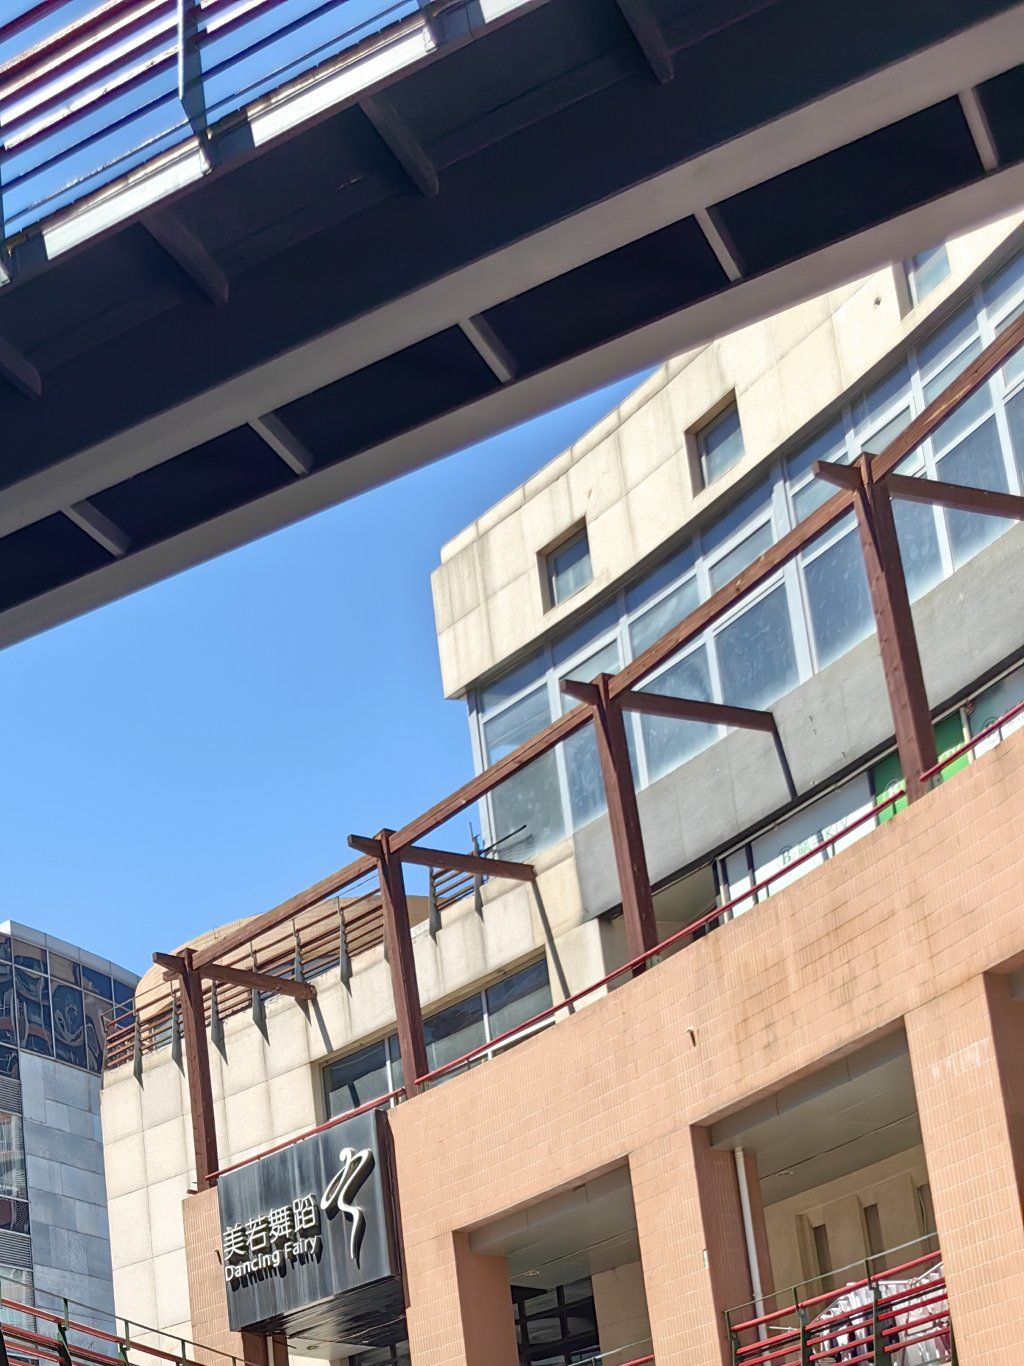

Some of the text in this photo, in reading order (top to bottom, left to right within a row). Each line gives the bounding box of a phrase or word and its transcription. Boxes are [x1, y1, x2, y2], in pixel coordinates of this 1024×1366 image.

[223, 1193, 317, 1260] 美若舞蹈
[225, 1235, 317, 1282] Dancing Fairy
